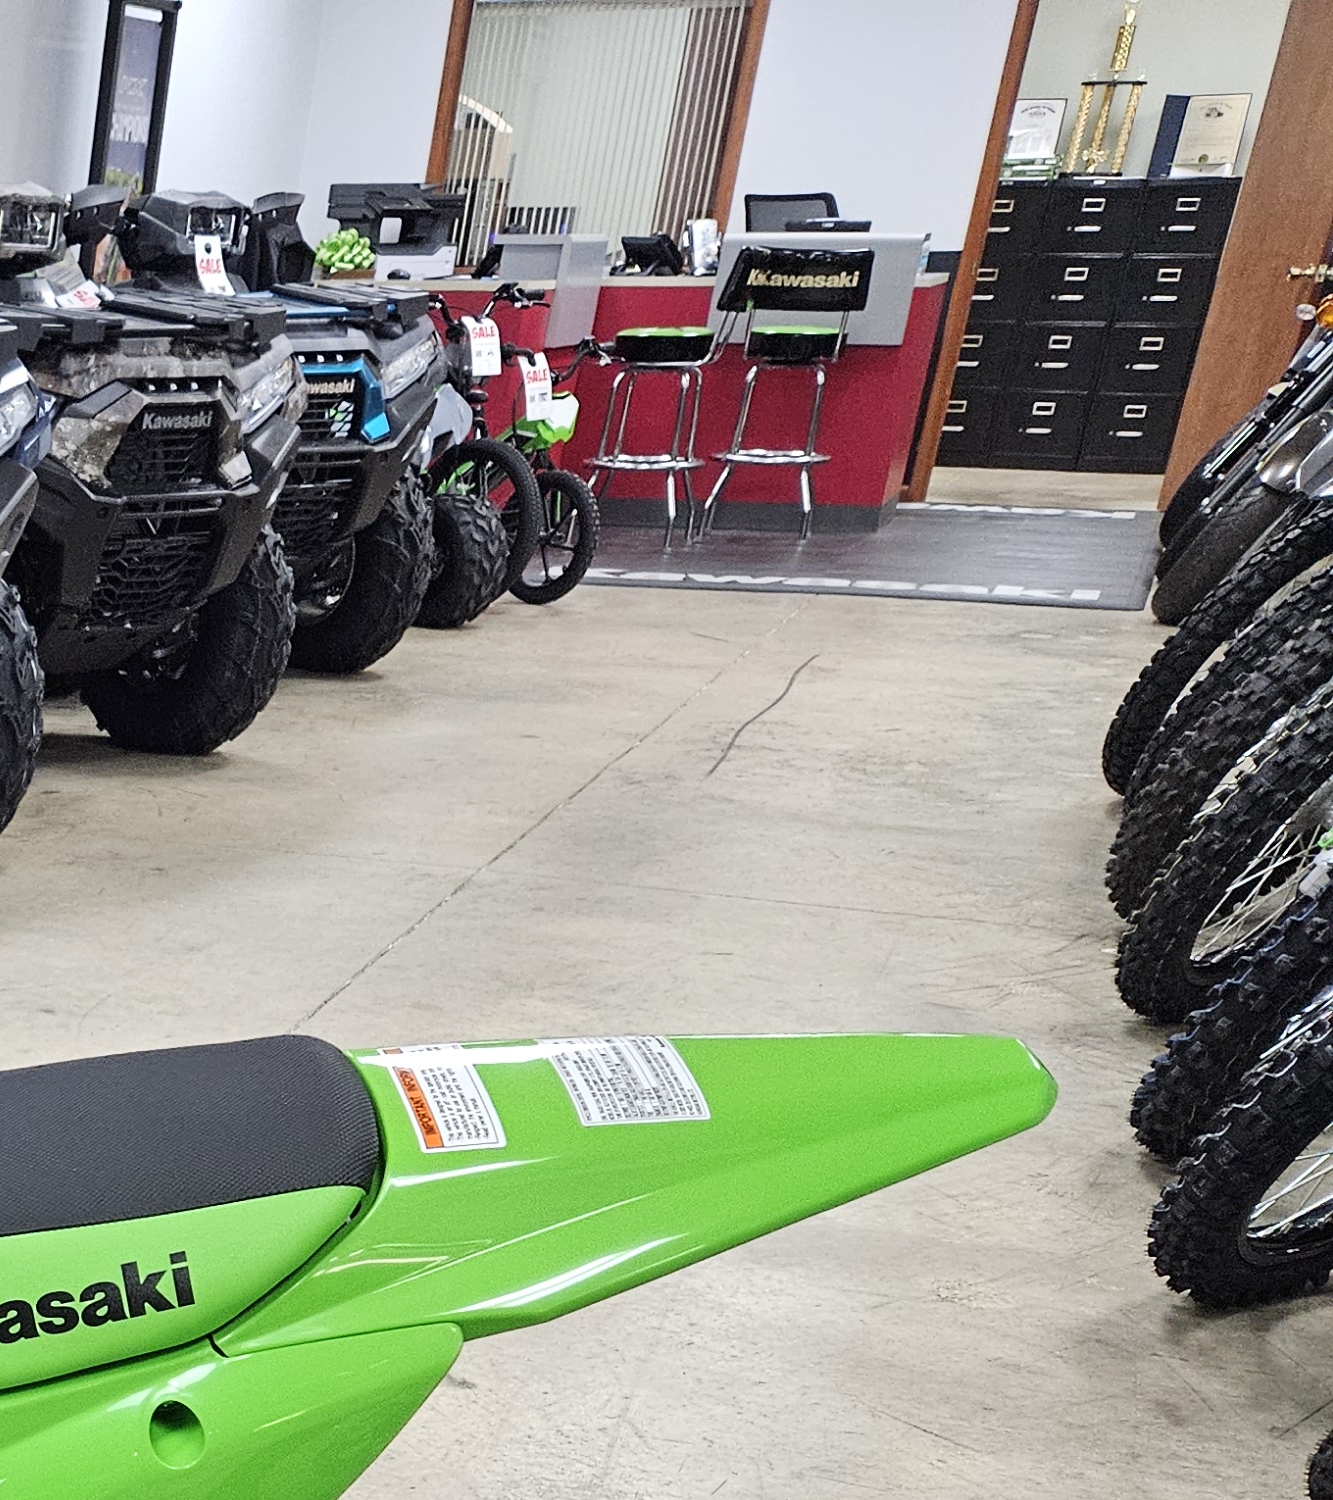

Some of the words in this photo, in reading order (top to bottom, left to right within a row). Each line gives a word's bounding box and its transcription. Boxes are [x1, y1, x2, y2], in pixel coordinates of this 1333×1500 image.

[199, 258, 222, 274] SALE
[472, 325, 496, 339] SALE
[526, 368, 548, 384] SALE
[307, 379, 354, 394] wasaki
[142, 410, 213, 430] Kawasaki
